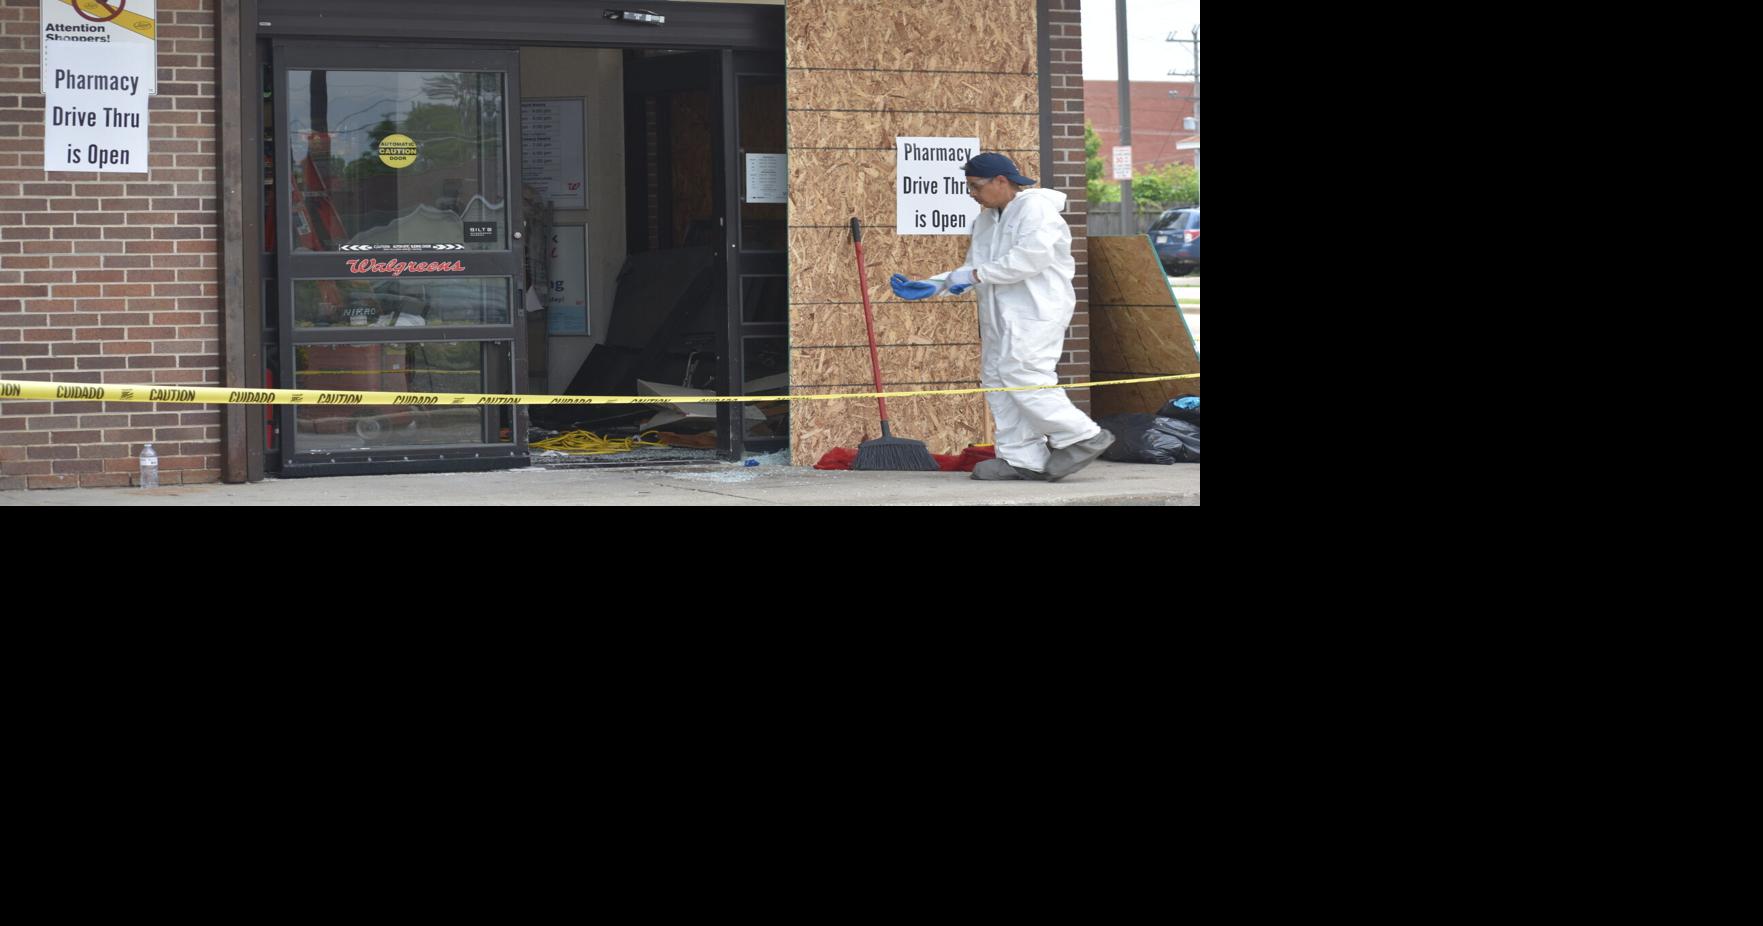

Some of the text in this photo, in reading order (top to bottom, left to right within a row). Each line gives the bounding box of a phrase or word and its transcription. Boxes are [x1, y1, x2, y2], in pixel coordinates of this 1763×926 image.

[45, 23, 105, 33] Attention
[55, 69, 139, 96] Pharmacy
[53, 106, 140, 128] Drive Thru
[67, 144, 130, 168] is Open
[904, 143, 972, 162] Pharmacy
[903, 176, 938, 195] Drive
[915, 209, 966, 232] is Open
[346, 258, 466, 277] Walgreens
[56, 385, 105, 400] CUIDADO
[149, 388, 196, 402] CAUTION
[229, 391, 276, 403] CUIDADO
[316, 393, 363, 404] CAUTION
